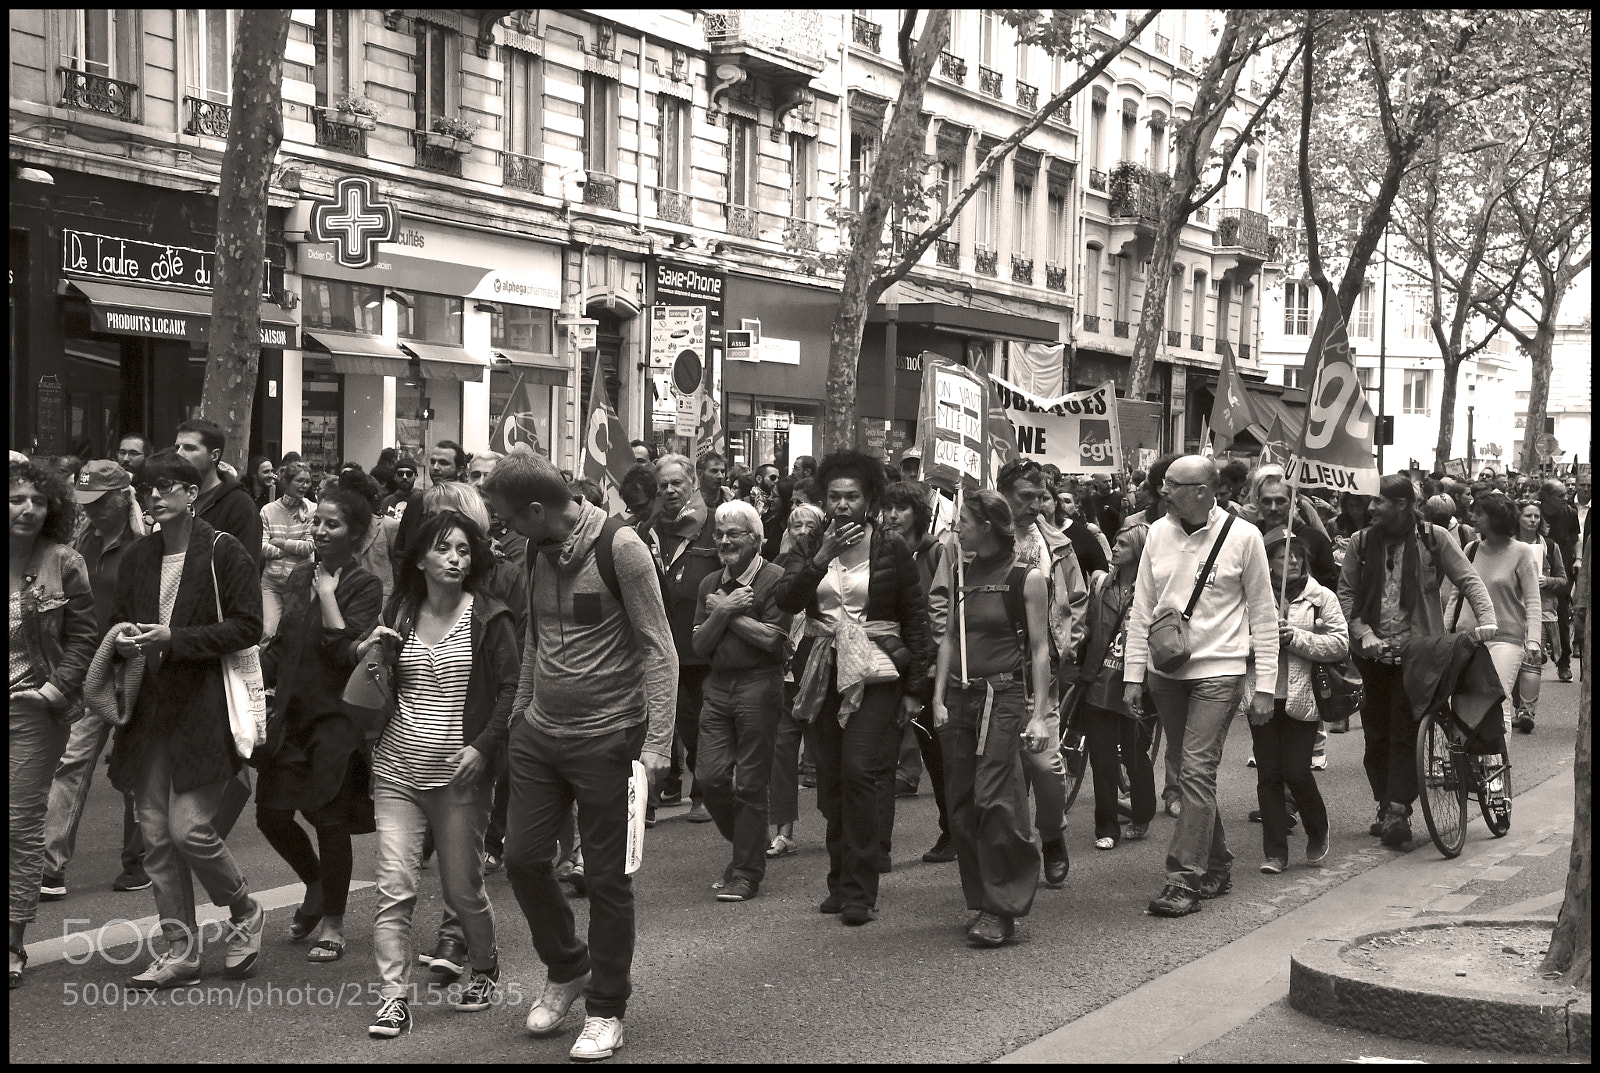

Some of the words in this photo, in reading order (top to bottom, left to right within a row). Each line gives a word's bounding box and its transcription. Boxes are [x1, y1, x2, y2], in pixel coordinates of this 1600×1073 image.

[71, 233, 88, 269] De
[97, 237, 139, 277] l'autre
[151, 246, 184, 281] côté
[195, 256, 210, 284] du
[502, 281, 527, 295] alphega
[657, 265, 722, 293] Saxe-Phone
[107, 312, 150, 332] PRODUITS
[152, 318, 186, 336] LOCAUX
[260, 328, 287, 345] SAISON
[936, 380, 951, 398] ON
[959, 386, 981, 409] VAUT
[938, 405, 980, 441] MIEUX
[936, 440, 959, 462] QUE
[1079, 439, 1113, 462] cgt
